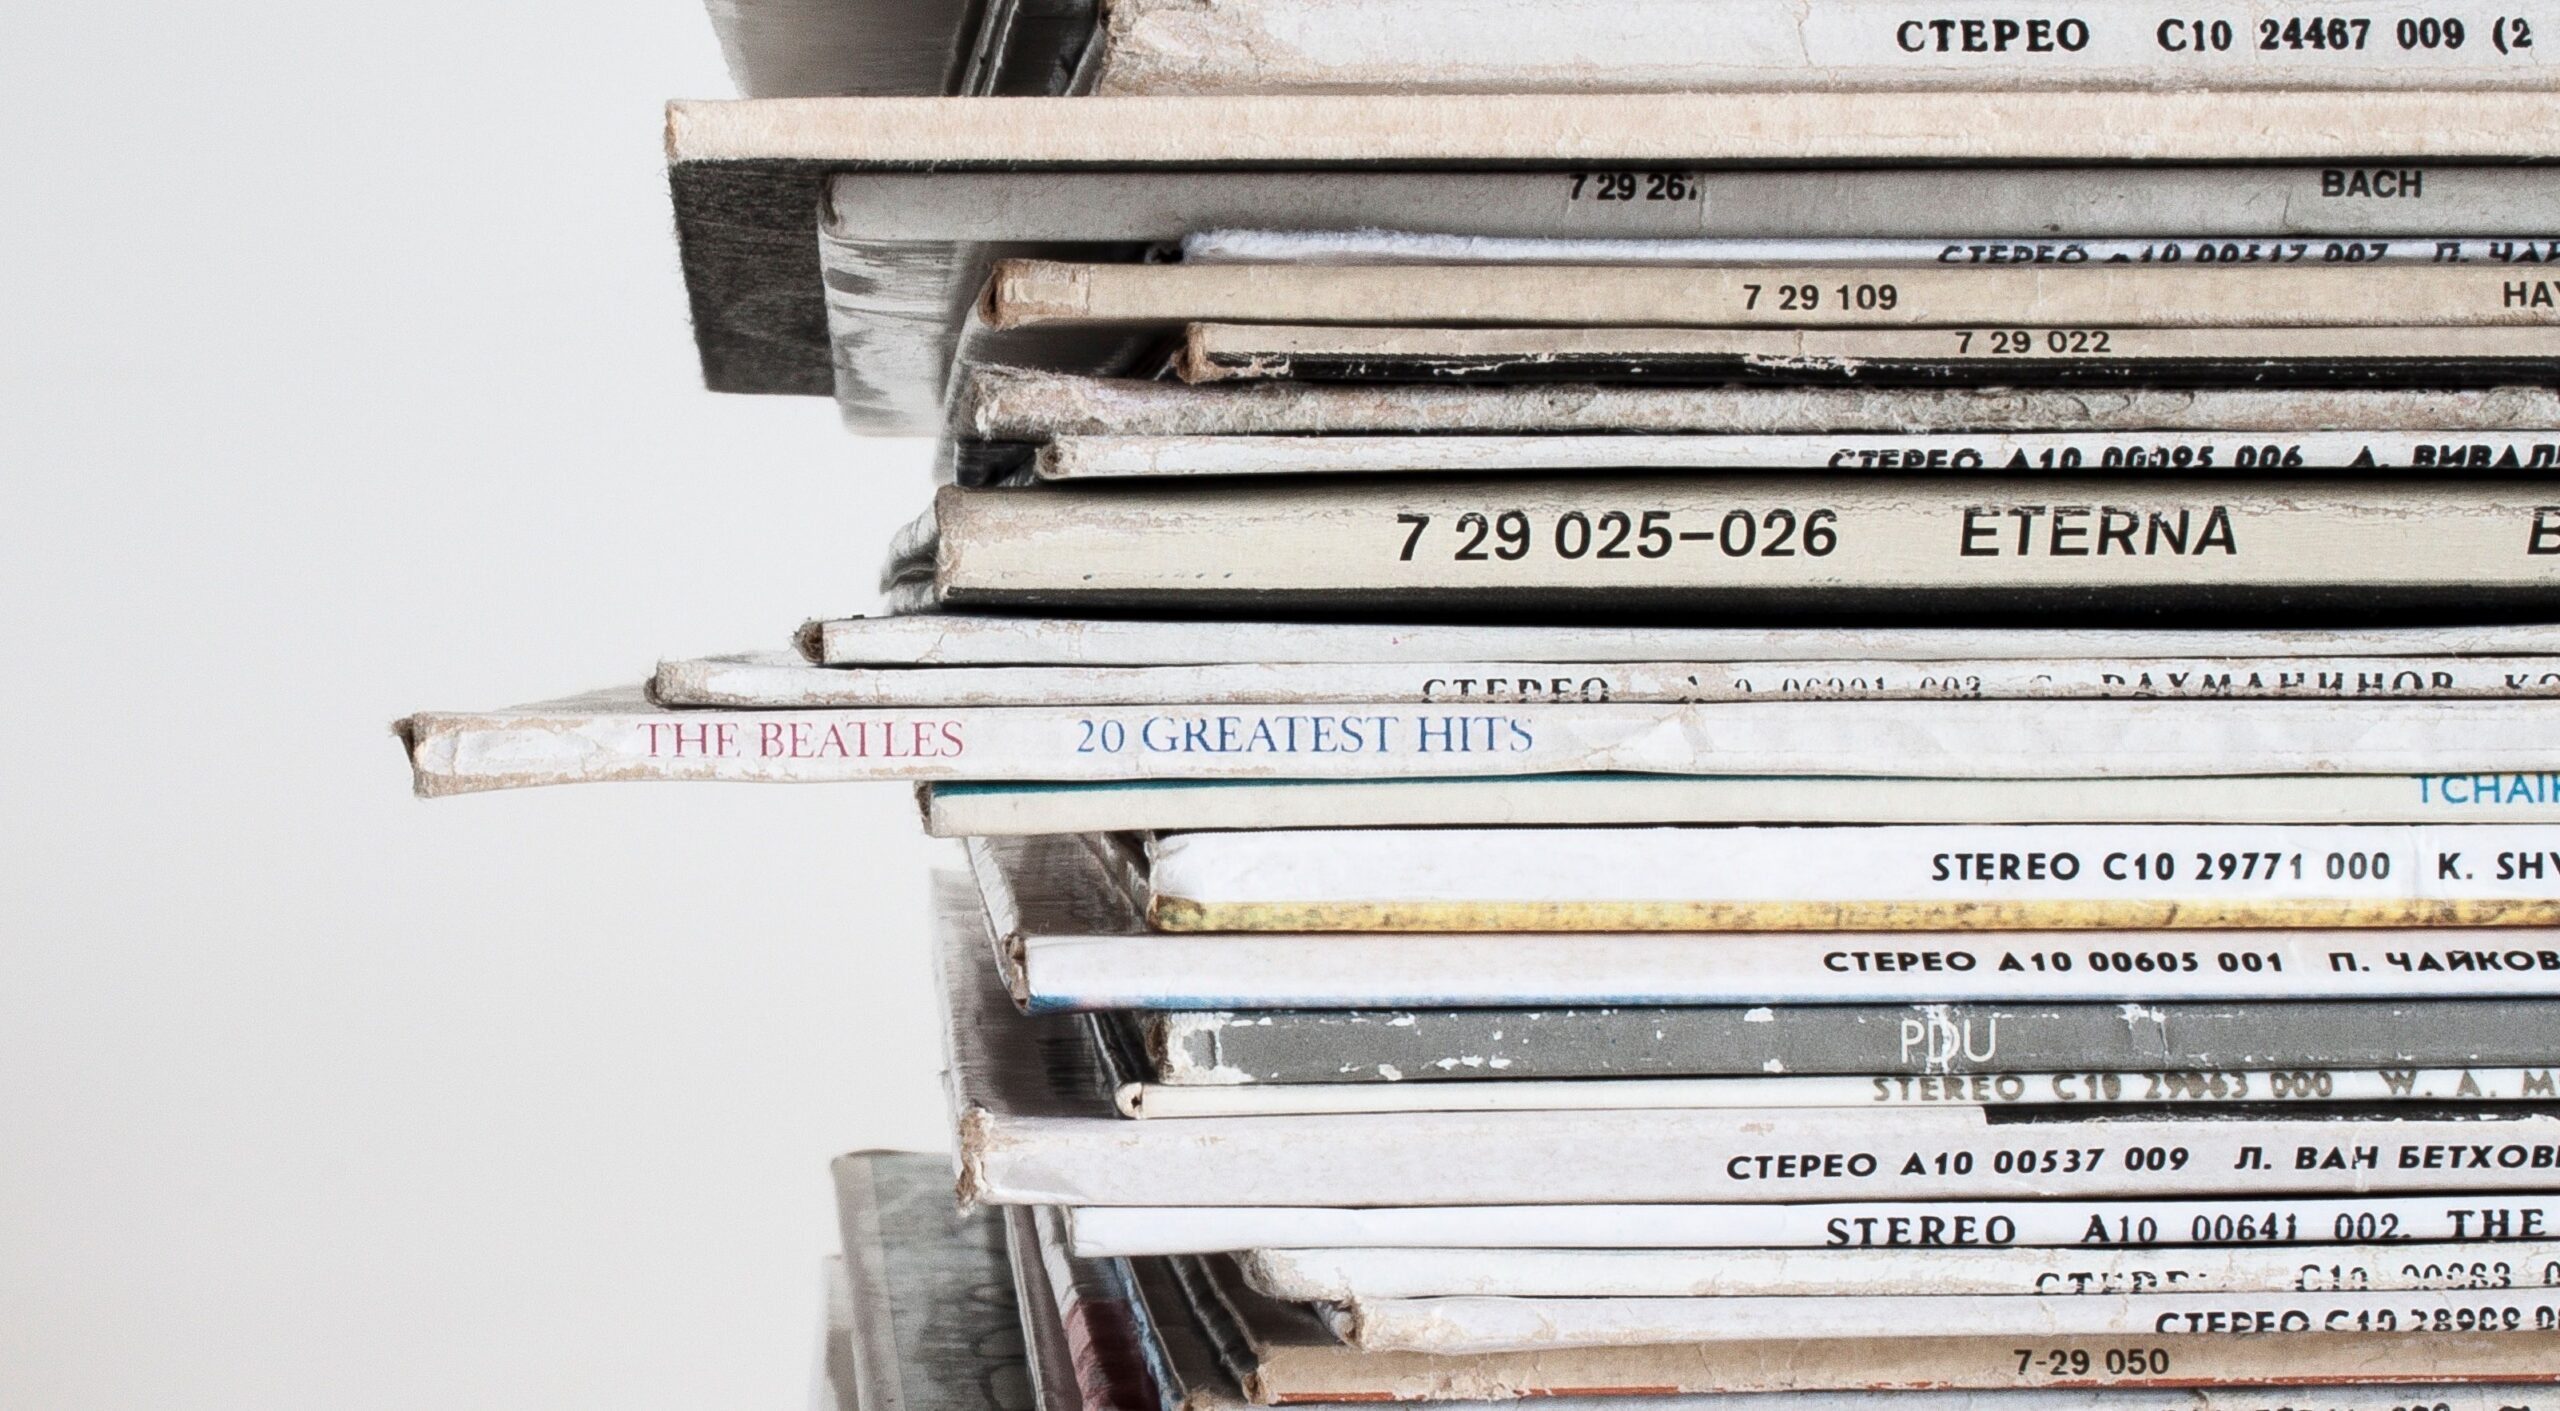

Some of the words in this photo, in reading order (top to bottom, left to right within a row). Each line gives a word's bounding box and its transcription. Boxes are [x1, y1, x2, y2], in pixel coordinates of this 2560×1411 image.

[1897, 18, 2090, 52] СТЕРЕО
[2156, 18, 2233, 51] С10
[2260, 17, 2371, 51] 24467
[2397, 17, 2465, 50] 009
[2492, 16, 2532, 55] (2
[1569, 173, 1589, 200] 7
[1597, 173, 1637, 201] 29
[2321, 170, 2422, 198] BACH
[1743, 285, 1762, 310] 7
[1779, 285, 1819, 310] 29
[1837, 284, 1898, 310] 109
[1955, 332, 1973, 353] 7
[1991, 332, 2031, 353] 29
[2047, 331, 2111, 353] 022
[2412, 444, 2560, 467] ВИВАЛ
[1397, 513, 1430, 561] 7
[1454, 509, 1531, 561] 29
[1960, 506, 2238, 556] ETERNA
[637, 723, 740, 758] THE
[758, 721, 964, 758] BEATLES
[1076, 719, 1125, 753] 20
[1142, 716, 1399, 753] GREATEST
[1417, 716, 1534, 753] HITS
[1932, 853, 2080, 881] STEREO
[2102, 852, 2175, 881] C10
[2195, 851, 2301, 880] 29771
[2326, 851, 2390, 880] 000
[2438, 852, 2473, 880] K.
[1823, 951, 1977, 972] СТЕРЕО
[1998, 952, 2073, 972] А10
[2088, 952, 2198, 972] 00605
[2217, 952, 2282, 972] 001
[2328, 952, 2370, 972] П.
[1901, 1018, 1996, 1063] PDU
[1726, 1152, 1878, 1181] СТЕРЕО
[1900, 1151, 1974, 1176] А10
[1993, 1148, 2105, 1174] 00537
[2124, 1147, 2190, 1172] 009
[2234, 1147, 2272, 1170] Л.
[2295, 1147, 2379, 1169] ВАН
[2398, 1144, 2560, 1169] БЕТХОВ
[1826, 1215, 2017, 1246] STEREO
[2081, 1213, 2157, 1243] A10
[2192, 1212, 2297, 1241] 00641
[2447, 1209, 2546, 1238] THE
[2014, 1348, 2090, 1375] 7-29
[2105, 1347, 2169, 1375] 050
